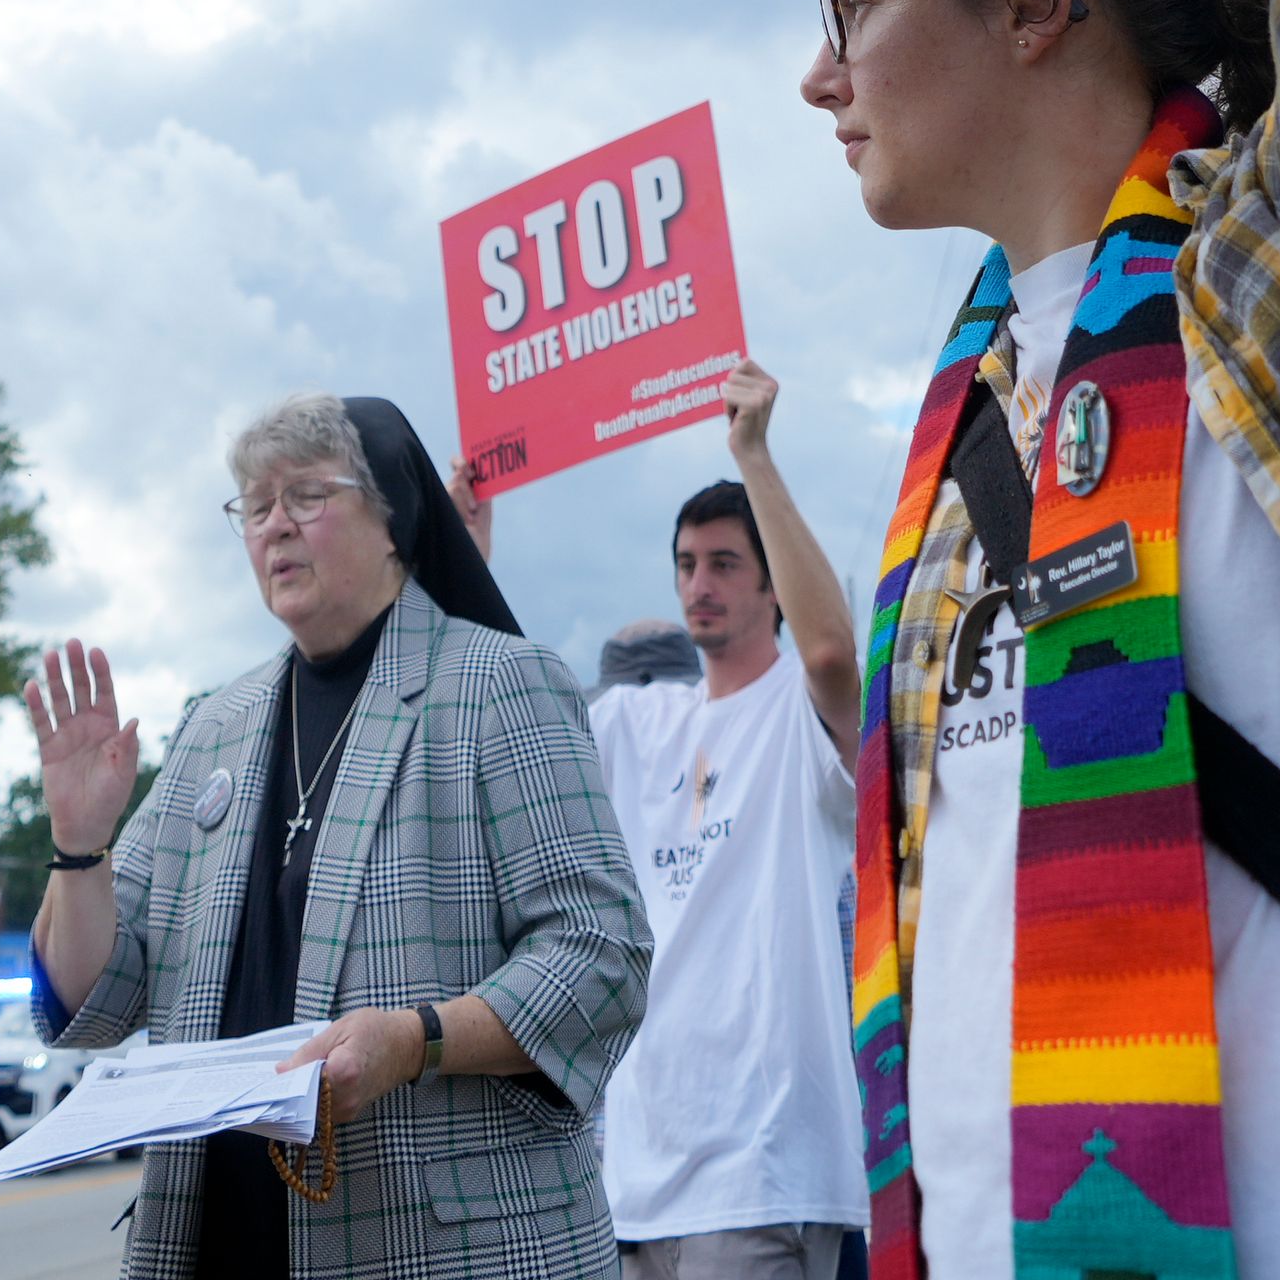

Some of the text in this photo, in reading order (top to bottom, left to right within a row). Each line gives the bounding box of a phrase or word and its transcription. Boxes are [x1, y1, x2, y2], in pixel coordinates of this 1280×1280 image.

[477, 155, 684, 333] STOP
[485, 272, 697, 393] STATE VIOLENCE
[1048, 540, 1125, 582] Rev. Hillary Taylor
[1091, 560, 1118, 578] Director
